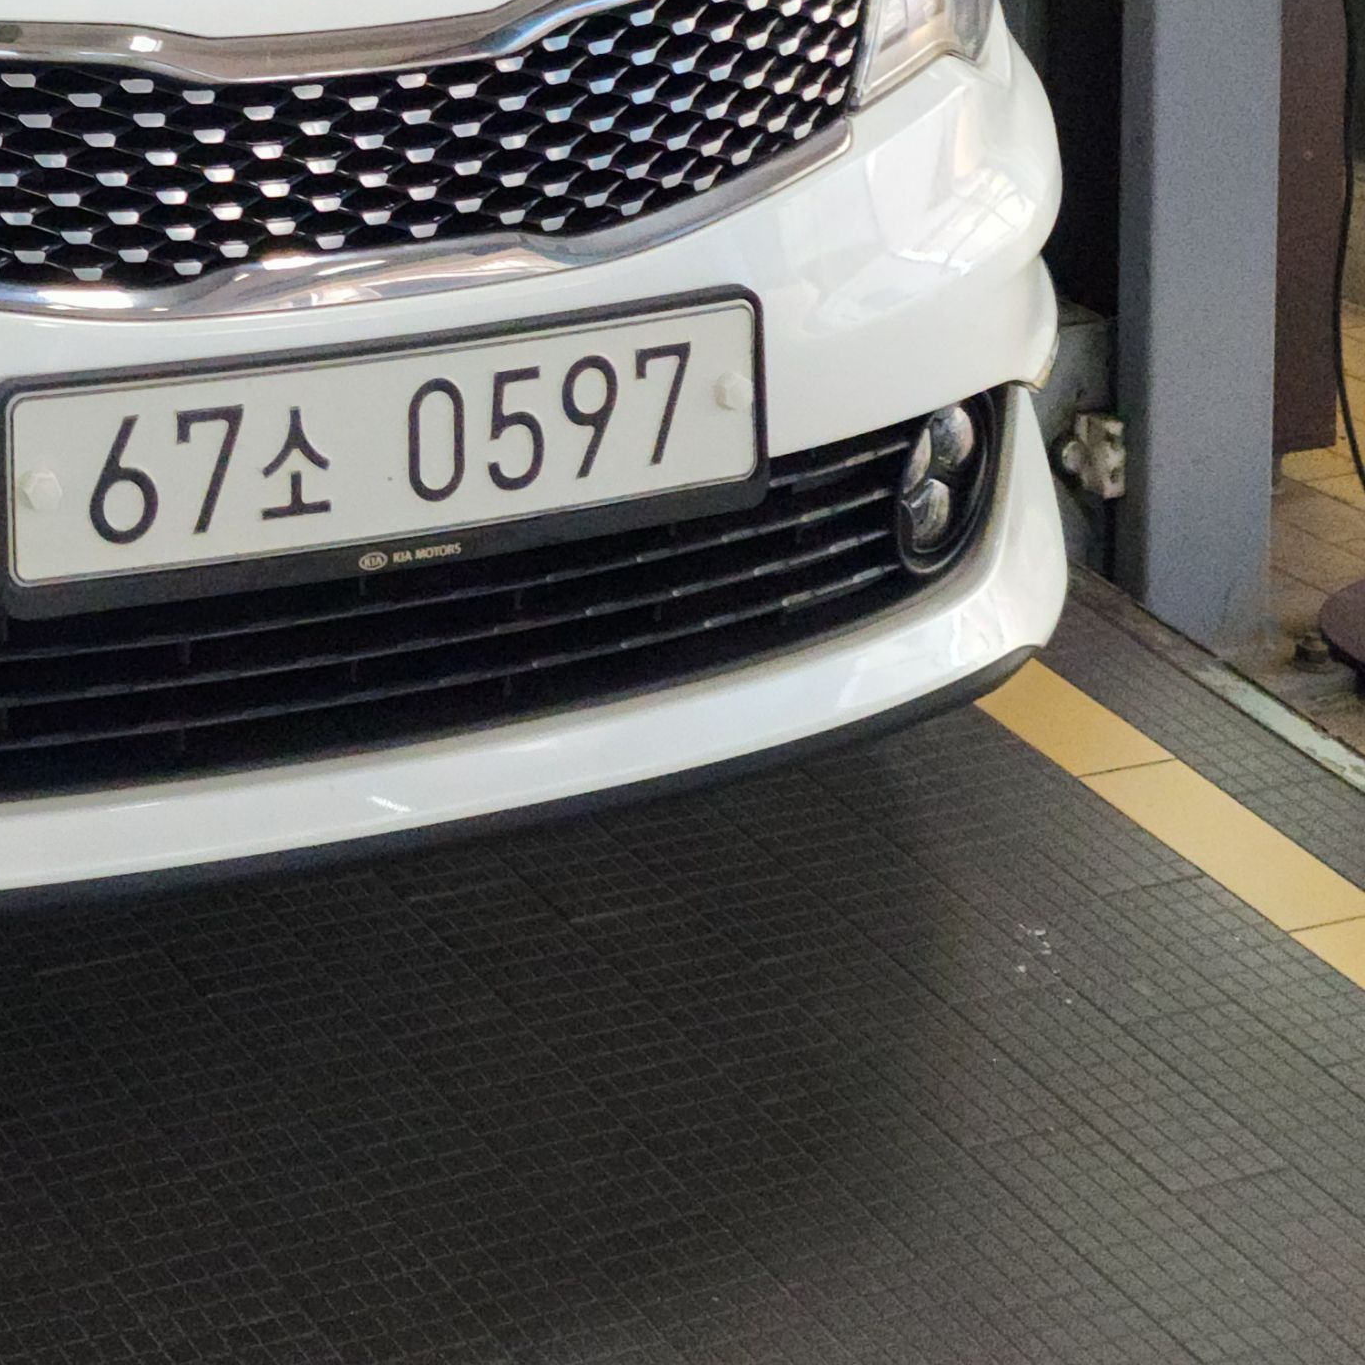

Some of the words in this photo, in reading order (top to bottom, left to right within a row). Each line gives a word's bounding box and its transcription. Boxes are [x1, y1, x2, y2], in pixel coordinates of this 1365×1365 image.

[88, 404, 332, 545] 67소
[405, 341, 693, 504] 0597
[392, 550, 413, 563] KIA
[415, 542, 462, 560] MOTORS
